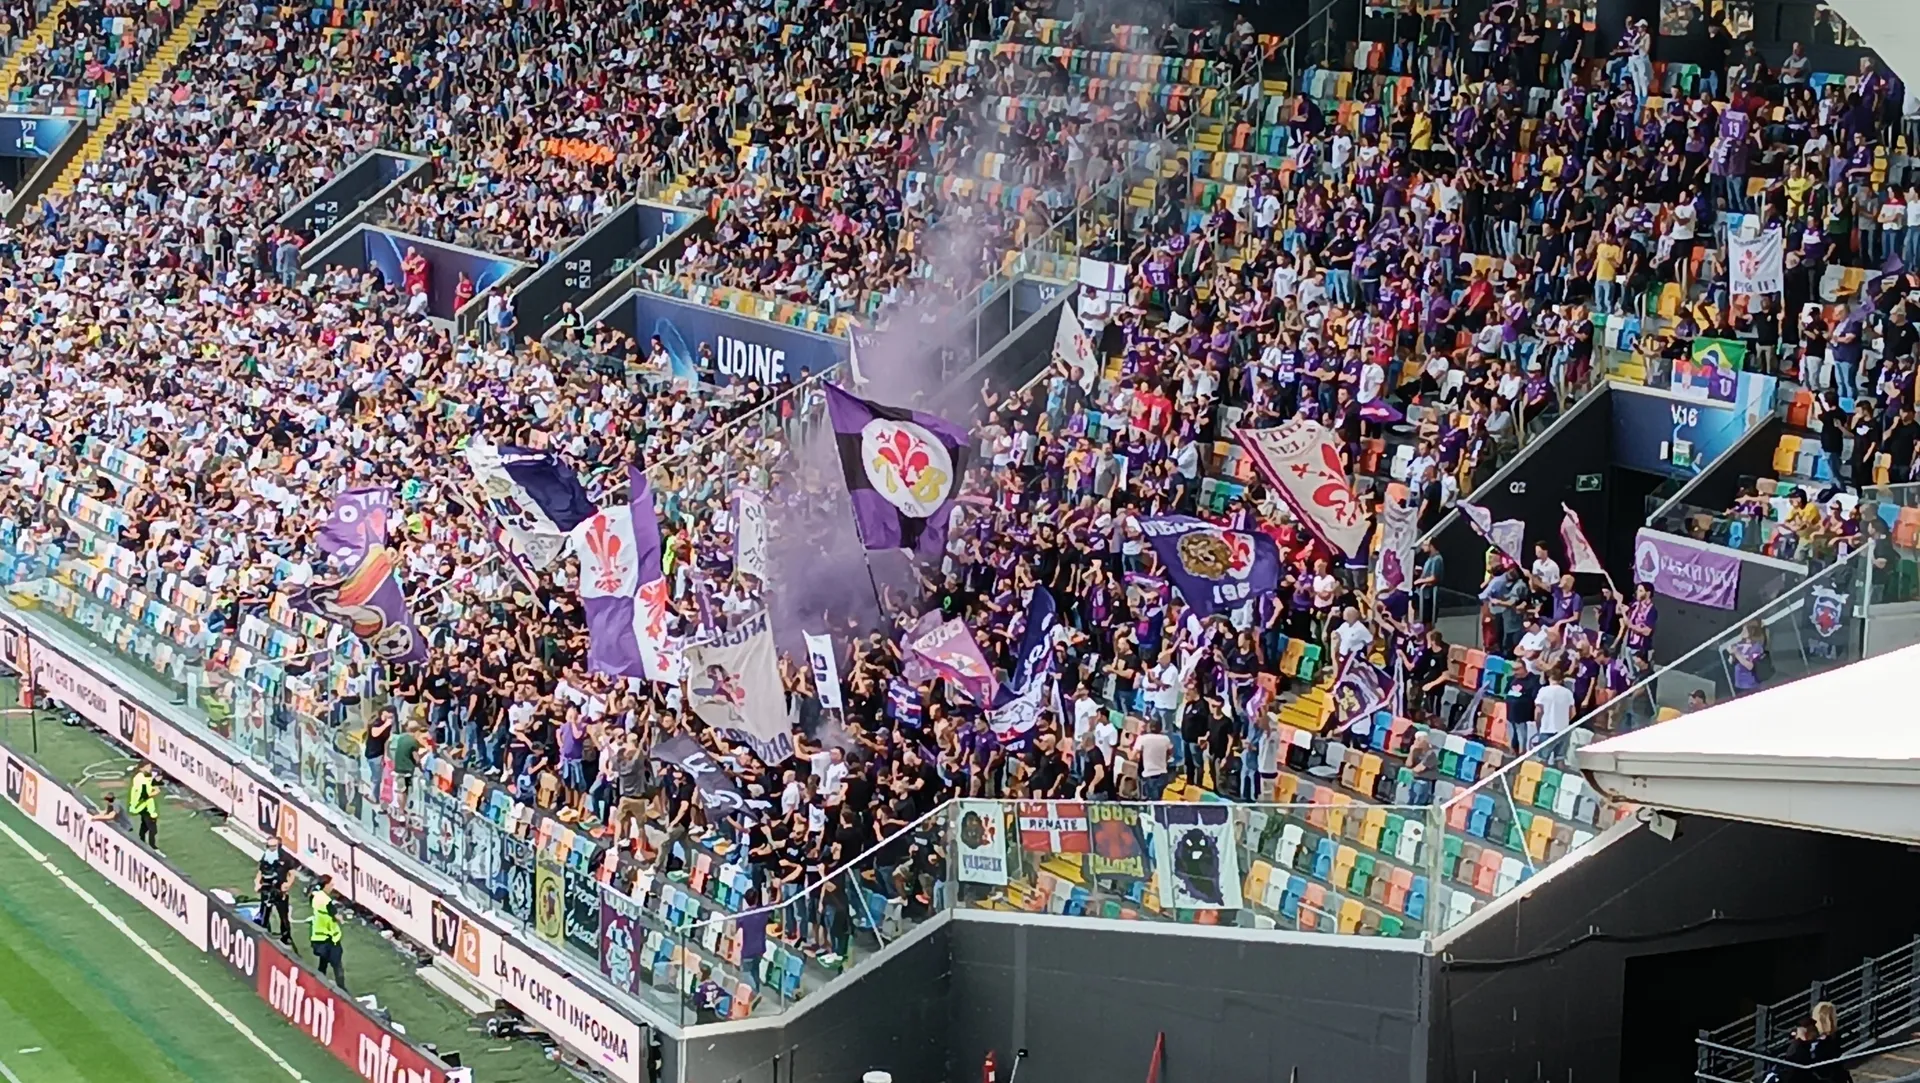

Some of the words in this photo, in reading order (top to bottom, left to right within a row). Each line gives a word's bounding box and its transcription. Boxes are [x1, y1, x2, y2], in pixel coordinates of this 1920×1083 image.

[717, 335, 786, 385] UDINE
[7, 763, 23, 800] TV
[259, 797, 279, 830] TV
[56, 799, 71, 835] LA
[73, 811, 87, 843] TV
[87, 826, 110, 865] CHE
[113, 844, 125, 876] TI
[128, 854, 189, 925] INFORMA
[331, 852, 349, 882] CHE
[210, 911, 255, 976] 00:00
[432, 906, 457, 948] TV
[493, 953, 509, 983] LA
[512, 966, 527, 991] TV
[529, 978, 553, 1012] CHE
[555, 994, 567, 1020] TI
[569, 1004, 629, 1063] INFORMA
